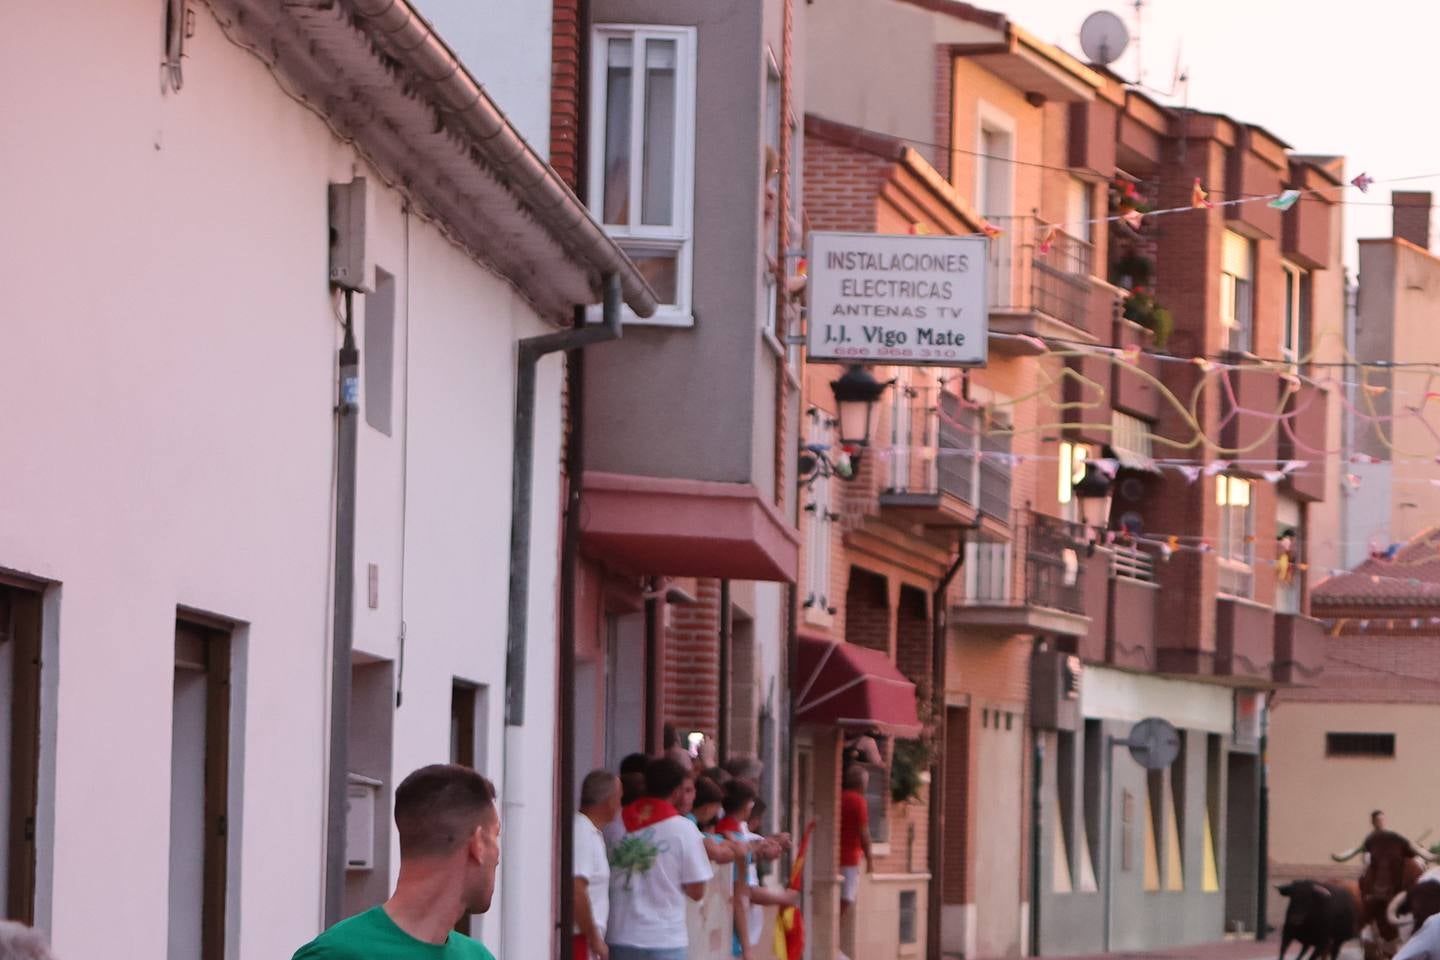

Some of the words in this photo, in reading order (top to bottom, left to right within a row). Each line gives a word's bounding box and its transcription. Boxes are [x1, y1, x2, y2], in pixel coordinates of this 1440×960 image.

[827, 251, 969, 273] INSTALACIONES
[841, 278, 953, 300] ELECTRICAS
[832, 304, 927, 319] ANTENAS
[937, 306, 963, 319] TV
[824, 324, 852, 345] J.J.
[862, 325, 907, 347] Vigo
[917, 327, 966, 346] Mate
